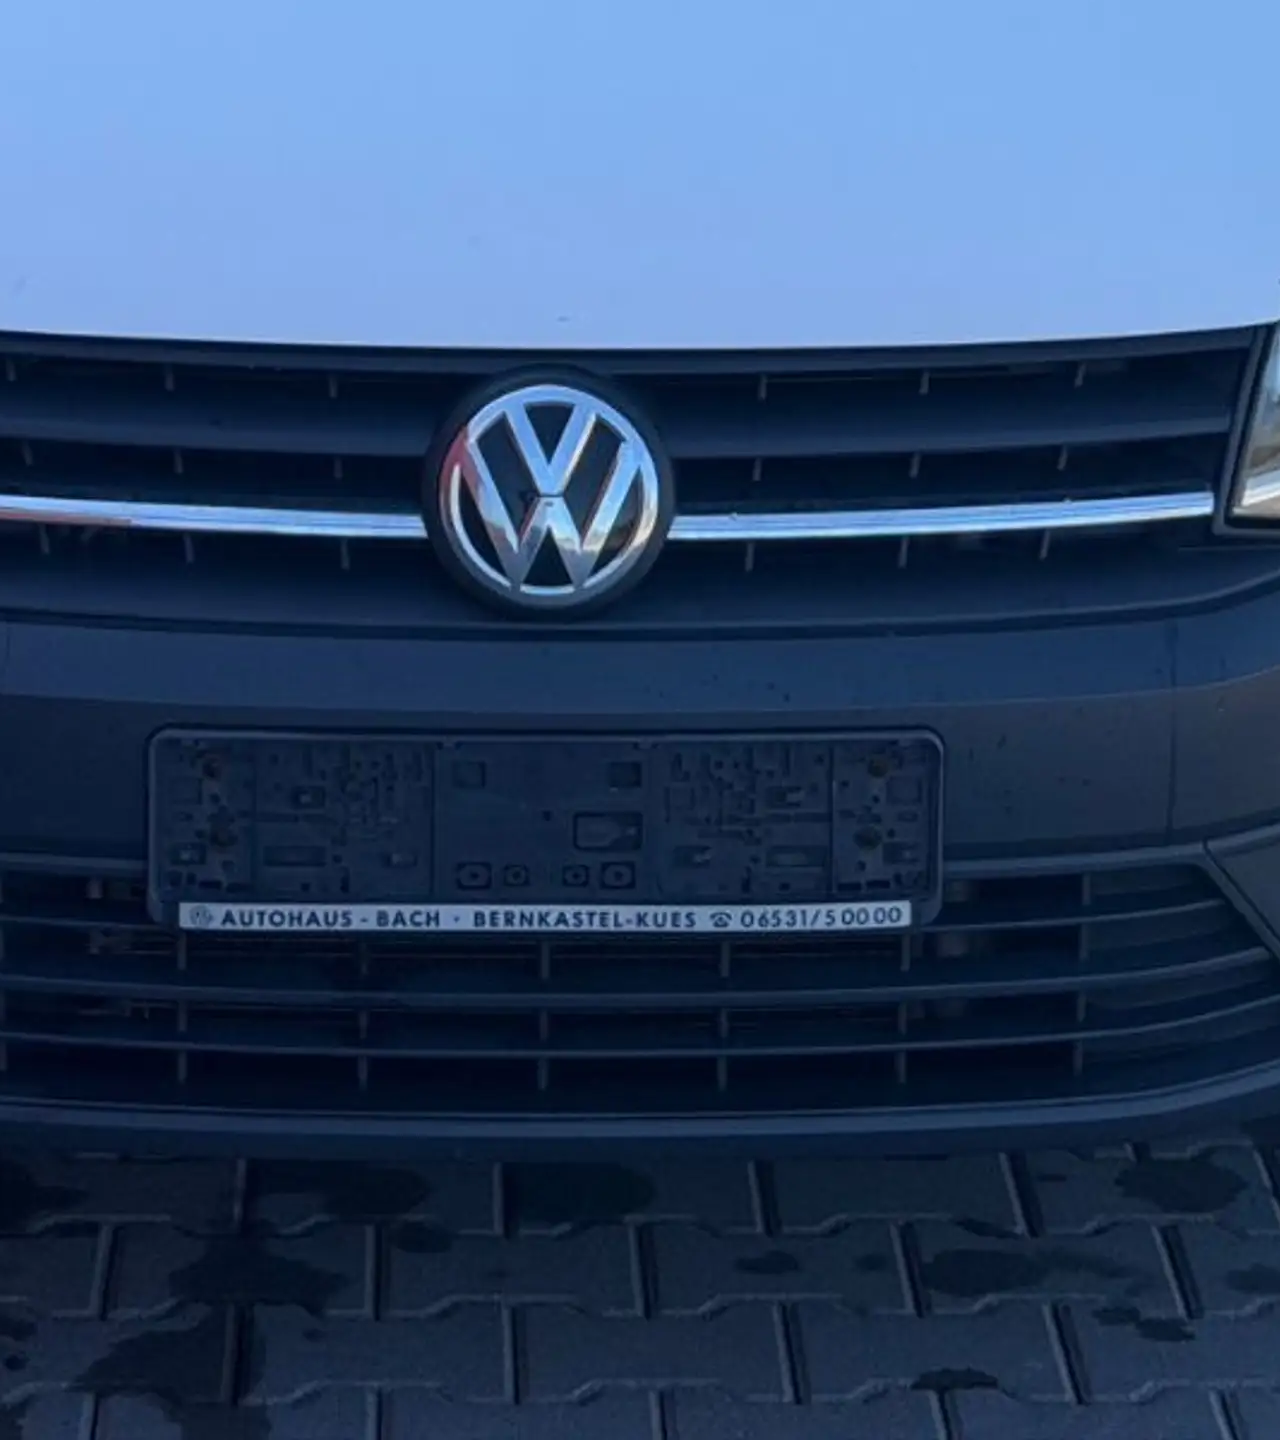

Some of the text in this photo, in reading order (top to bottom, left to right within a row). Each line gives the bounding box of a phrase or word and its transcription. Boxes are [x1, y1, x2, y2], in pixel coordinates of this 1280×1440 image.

[438, 384, 659, 602] VW
[220, 909, 353, 928] AUTOHAUS
[375, 909, 441, 928] BACH
[472, 909, 698, 929] BERNKASTEL-KUES
